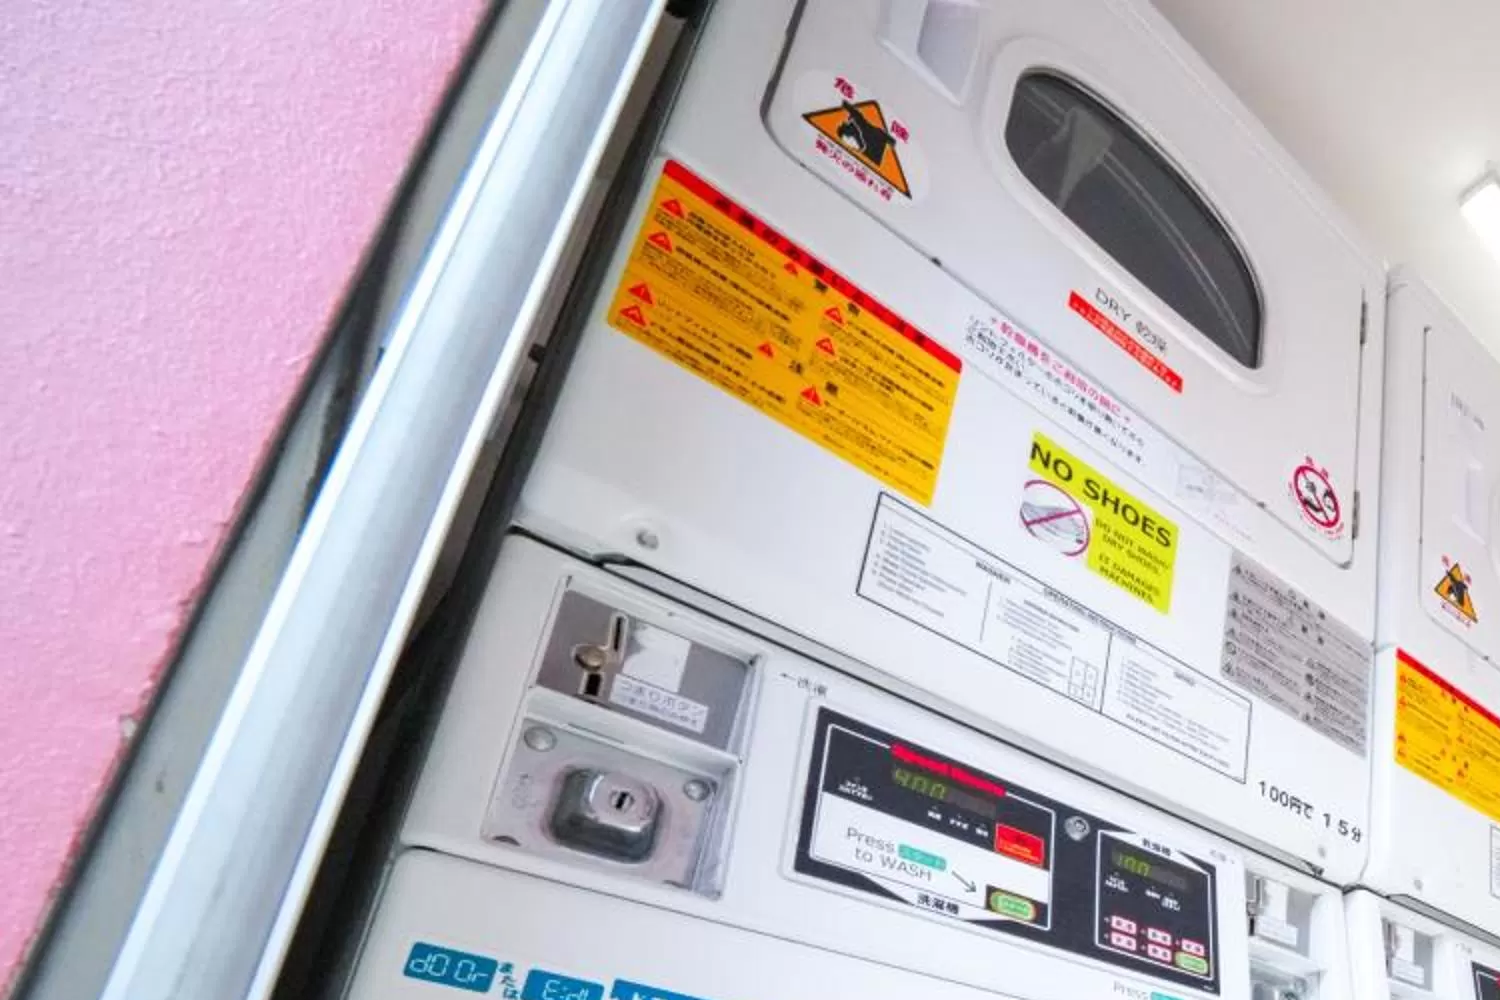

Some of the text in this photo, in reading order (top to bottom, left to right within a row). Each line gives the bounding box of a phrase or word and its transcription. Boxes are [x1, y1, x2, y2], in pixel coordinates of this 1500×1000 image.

[1095, 287, 1132, 322] DRY
[1030, 440, 1172, 549] NO SHOES
[1258, 780, 1314, 820] 100円で
[847, 827, 895, 852] Press
[855, 847, 874, 864] to
[879, 854, 933, 882] WASH
